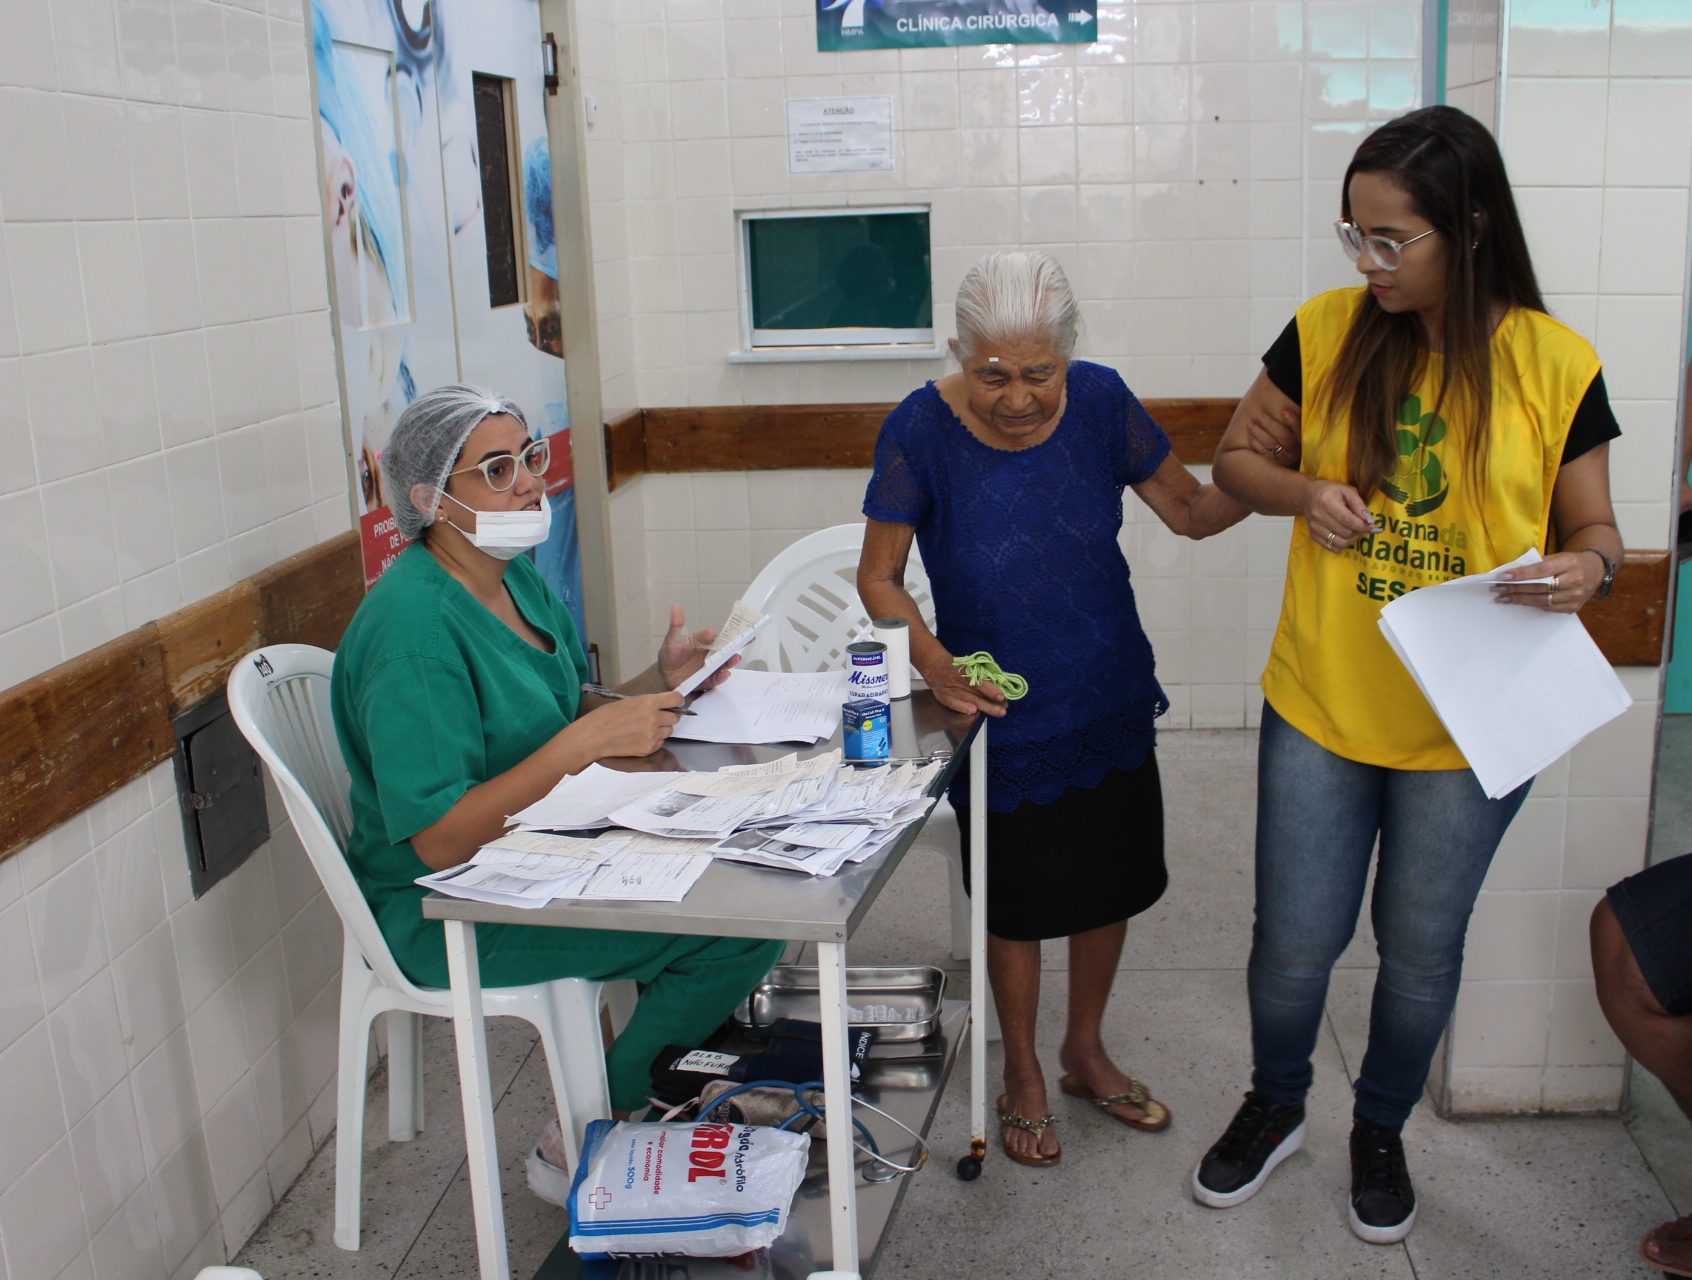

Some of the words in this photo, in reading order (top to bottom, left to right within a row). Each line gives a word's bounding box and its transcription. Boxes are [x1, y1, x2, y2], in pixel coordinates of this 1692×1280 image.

[841, 28, 864, 36] HMPA
[896, 14, 962, 33] CLÍNICA
[966, 11, 1059, 29] CIRÚRGICA
[823, 107, 854, 115] ATENÇÃO
[1370, 511, 1439, 542] avana
[389, 533, 400, 549] DE
[381, 553, 397, 573] NÃO
[1347, 532, 1466, 577] idadania
[848, 671, 888, 684] Missner
[643, 1146, 652, 1181] economia
[653, 1149, 664, 1195] comodidade
[624, 1166, 636, 1190] 500g
